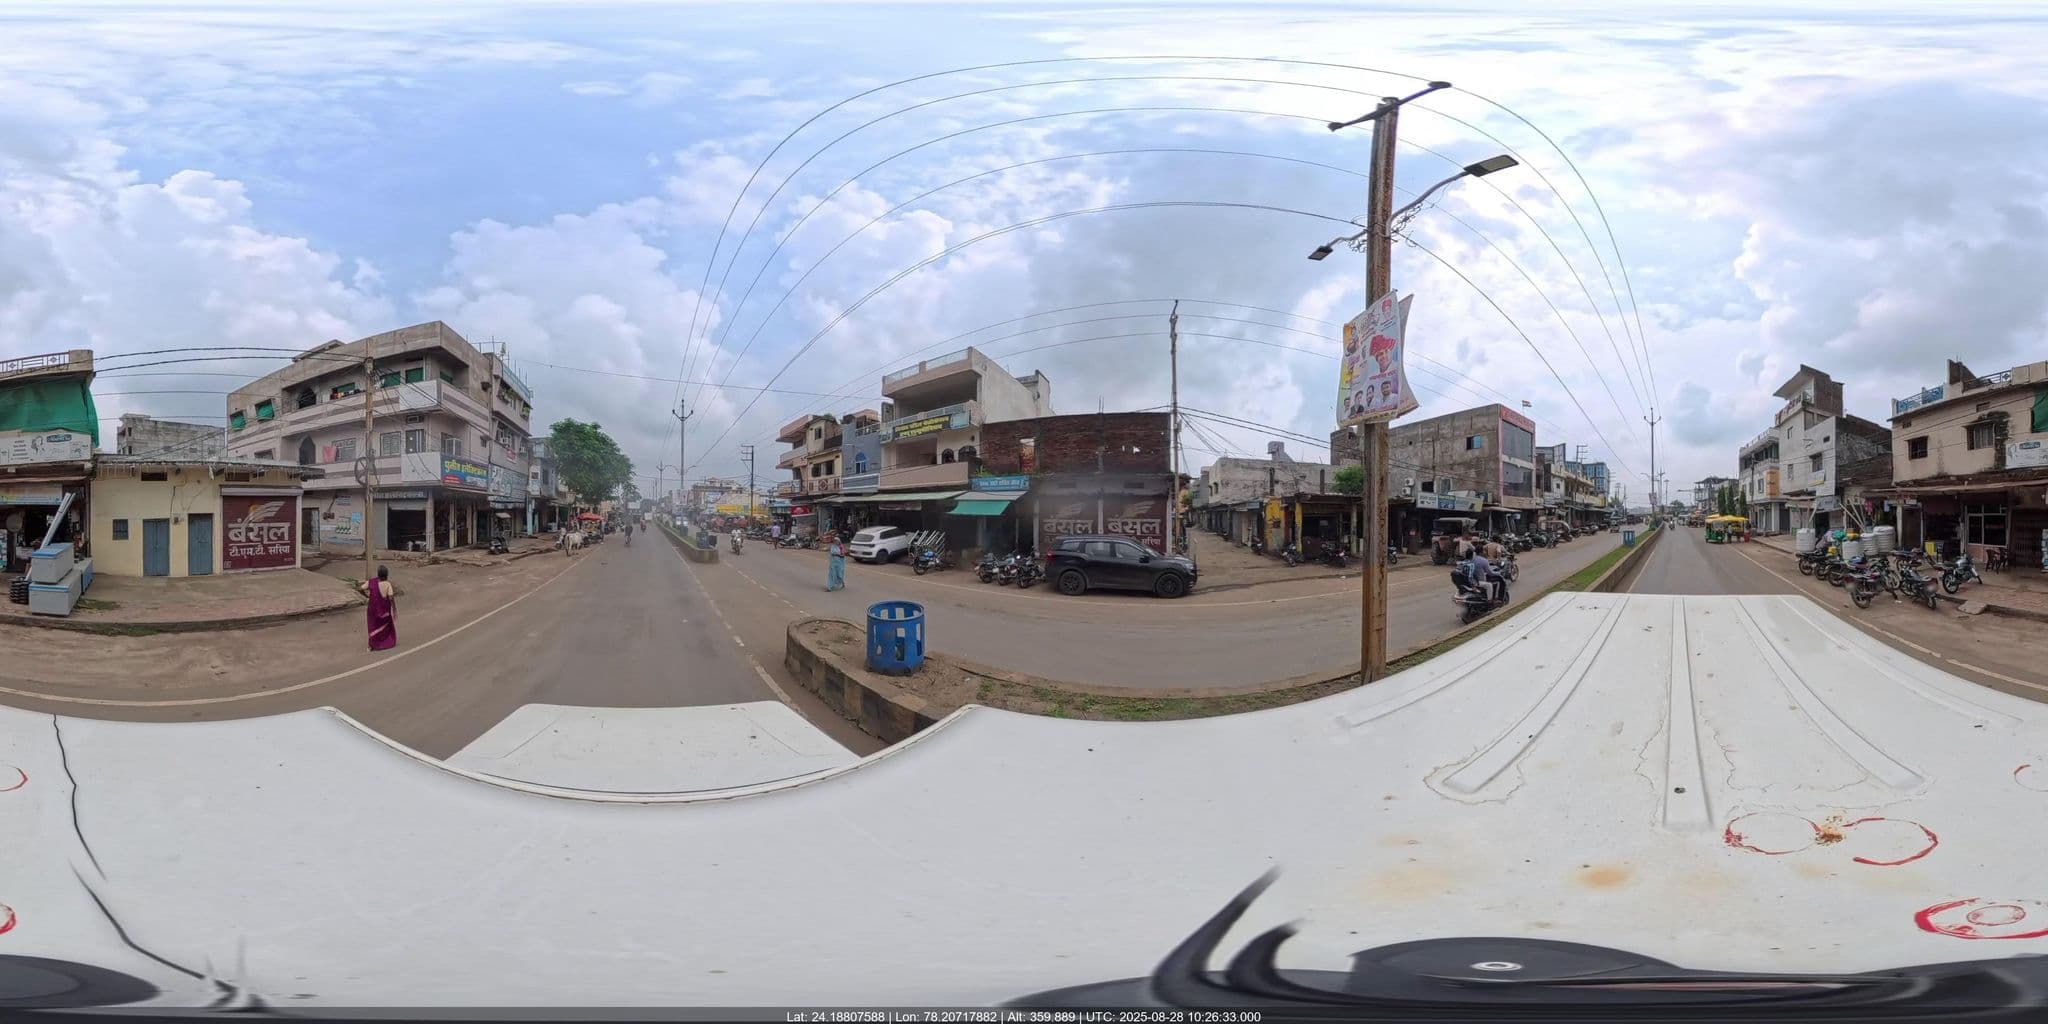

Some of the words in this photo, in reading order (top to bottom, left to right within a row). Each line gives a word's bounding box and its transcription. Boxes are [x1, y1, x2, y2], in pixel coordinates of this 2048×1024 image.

[228, 518, 291, 544] बंसल
[1043, 515, 1093, 536] बंसल
[1107, 514, 1161, 536] बंसल
[229, 546, 266, 559] टी.एम.टी.
[268, 544, 291, 555] सरिया
